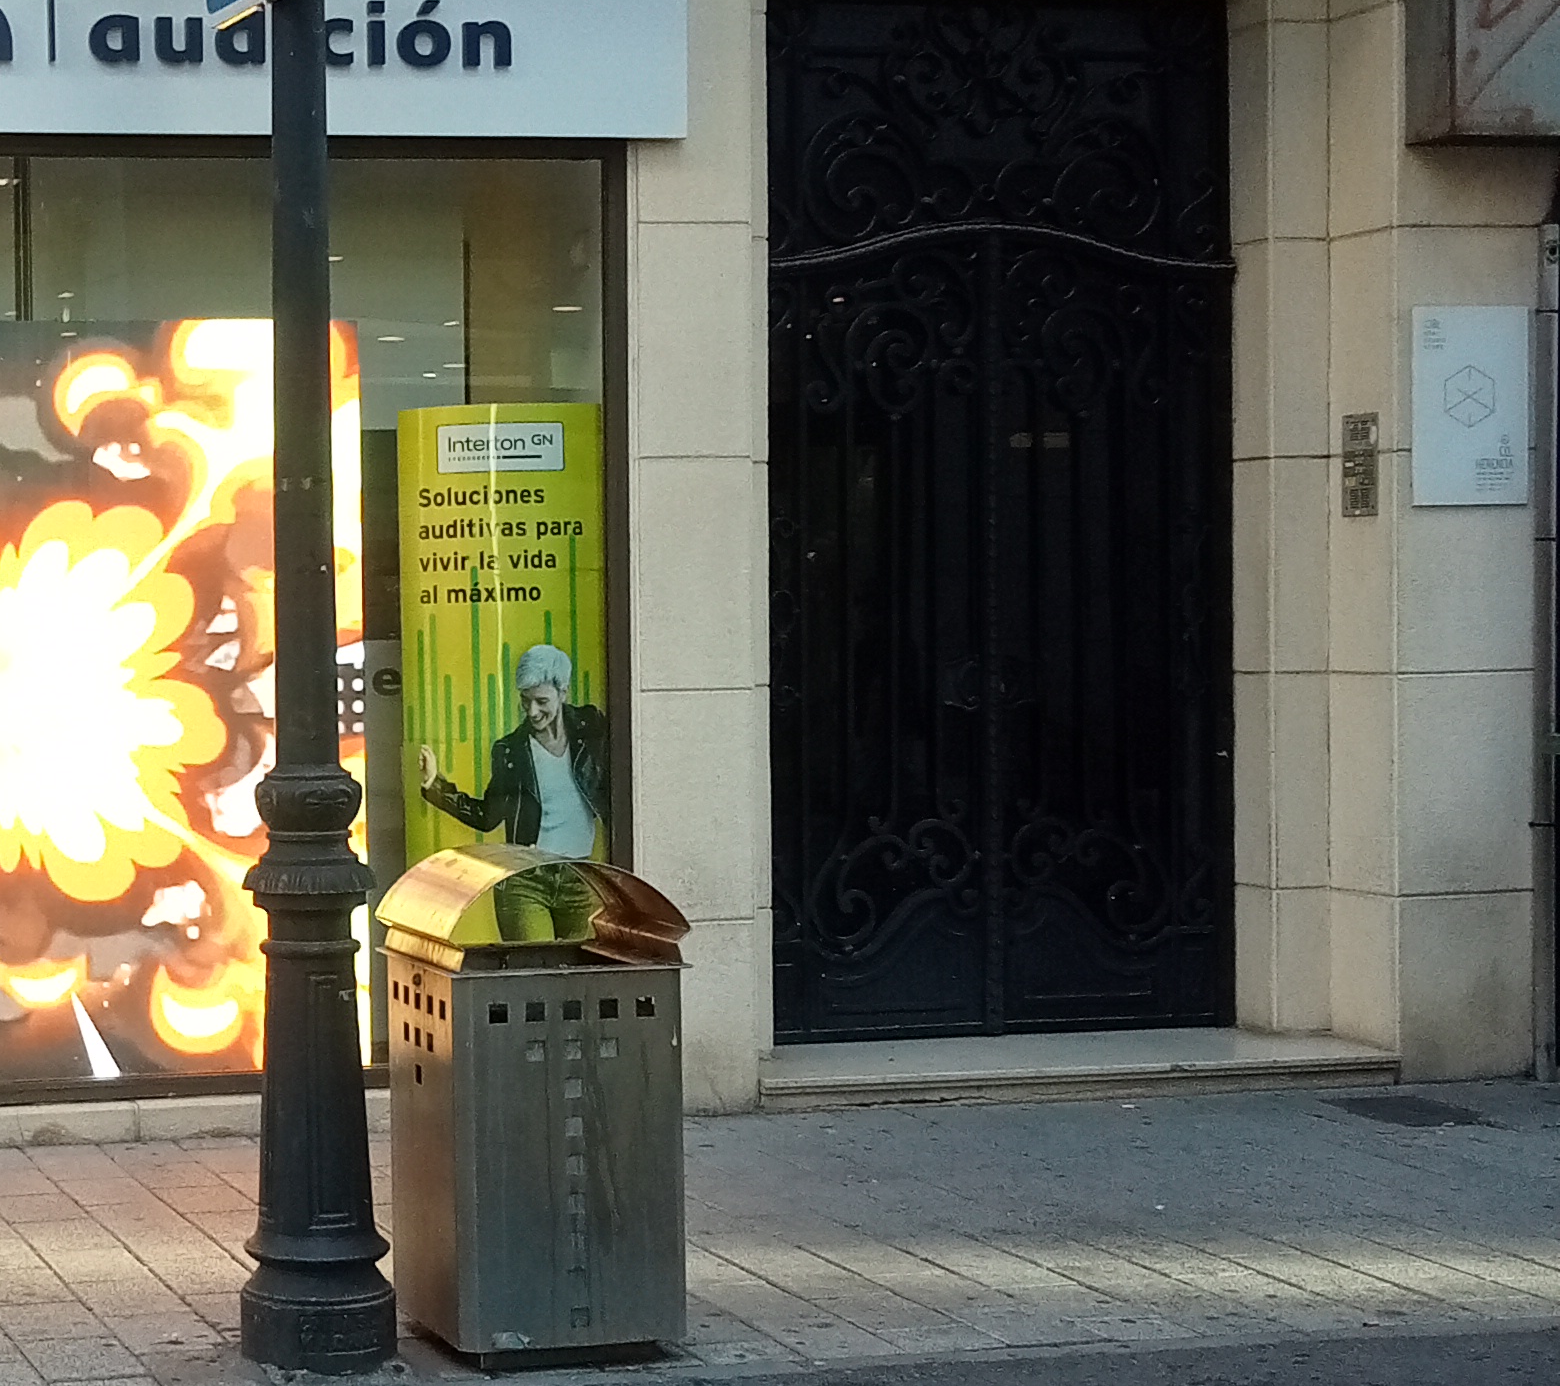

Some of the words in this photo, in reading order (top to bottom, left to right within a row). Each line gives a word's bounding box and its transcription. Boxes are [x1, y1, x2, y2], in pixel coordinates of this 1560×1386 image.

[88, 0, 513, 69] audción
[447, 436, 526, 453] Interton
[531, 433, 554, 446] GN
[418, 485, 545, 508] Soluciones
[418, 518, 527, 540] auditivas
[536, 520, 583, 540] para
[419, 551, 469, 572] vivir
[479, 550, 499, 570] la
[508, 549, 557, 569] vida
[420, 584, 438, 604] al
[446, 582, 541, 604] máximo
